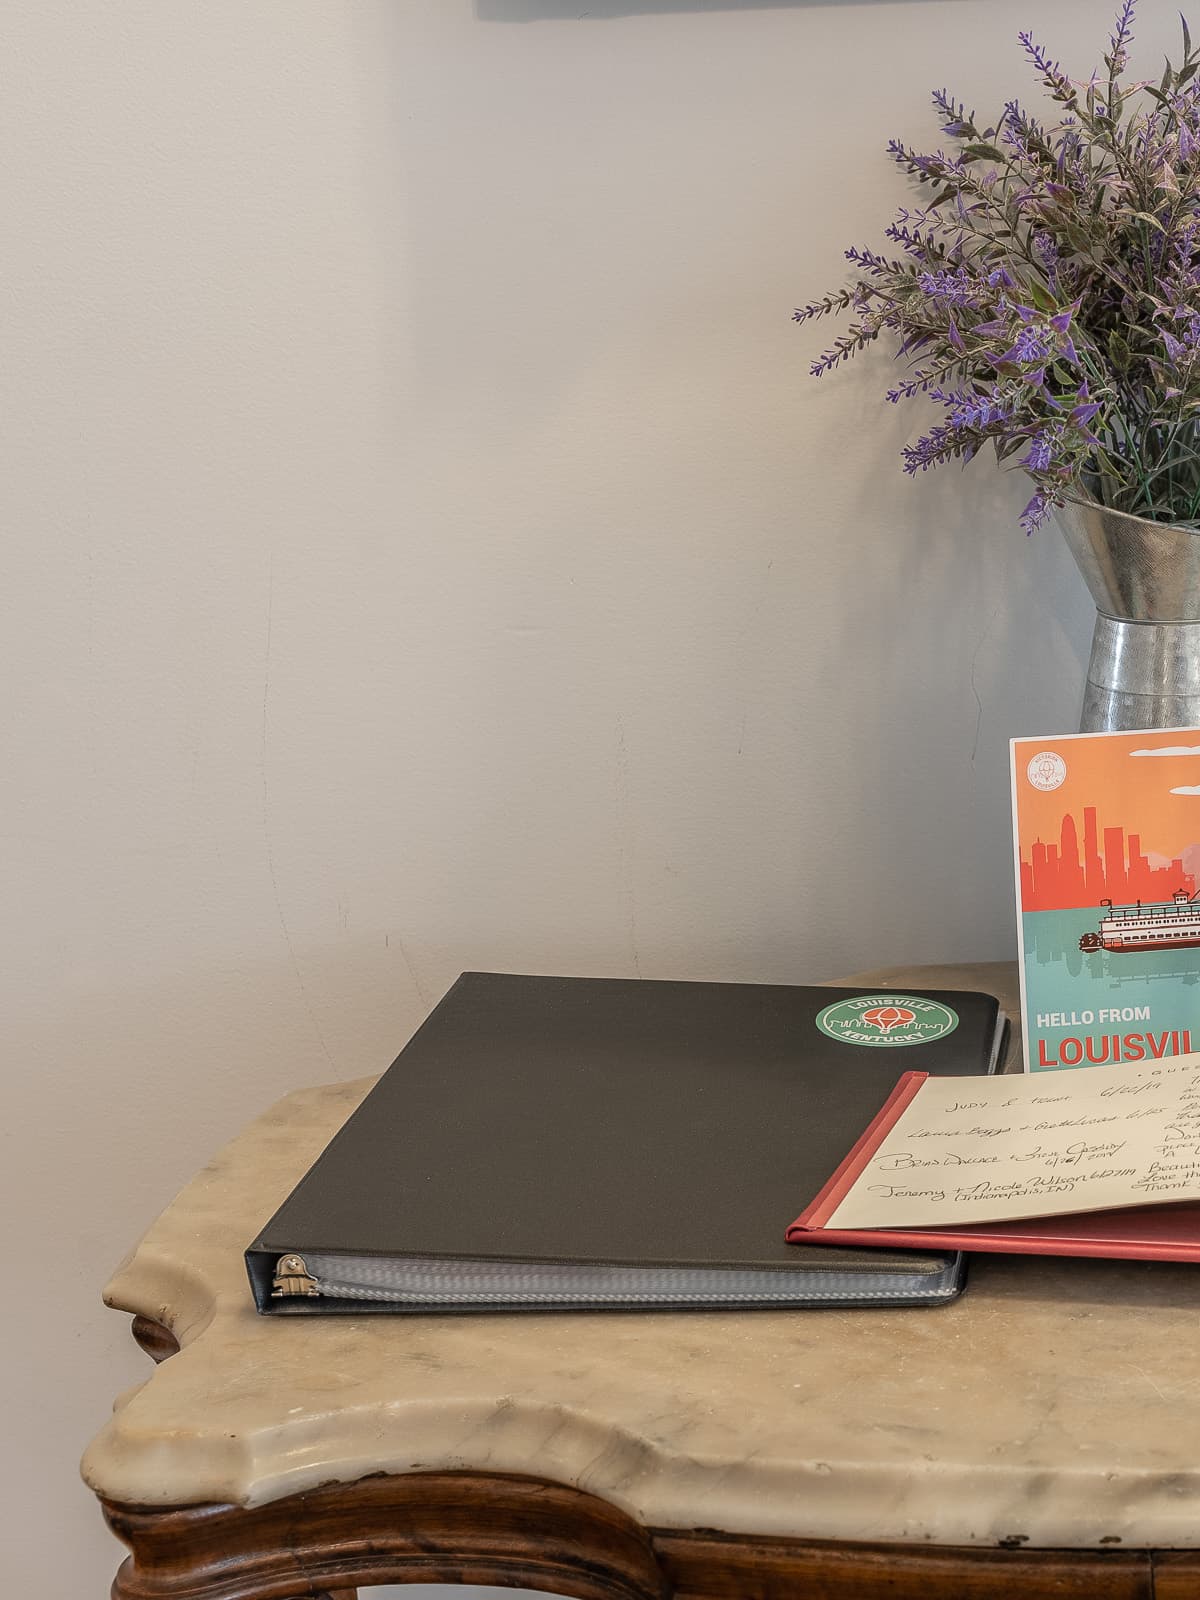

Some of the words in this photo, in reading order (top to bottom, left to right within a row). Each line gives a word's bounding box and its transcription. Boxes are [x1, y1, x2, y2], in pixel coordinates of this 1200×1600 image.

[847, 999, 936, 1012] LOUISVILLE
[1036, 1010, 1095, 1028] HELLO
[1099, 1006, 1151, 1024] FROM
[841, 1030, 925, 1043] KENTUCKY
[1137, 1172, 1177, 1185] Love
[867, 1184, 946, 1202] Jeremy
[971, 1180, 1022, 1194] Nicole
[1027, 1175, 1088, 1187] Wilson
[1130, 1181, 1190, 1192] Thank
